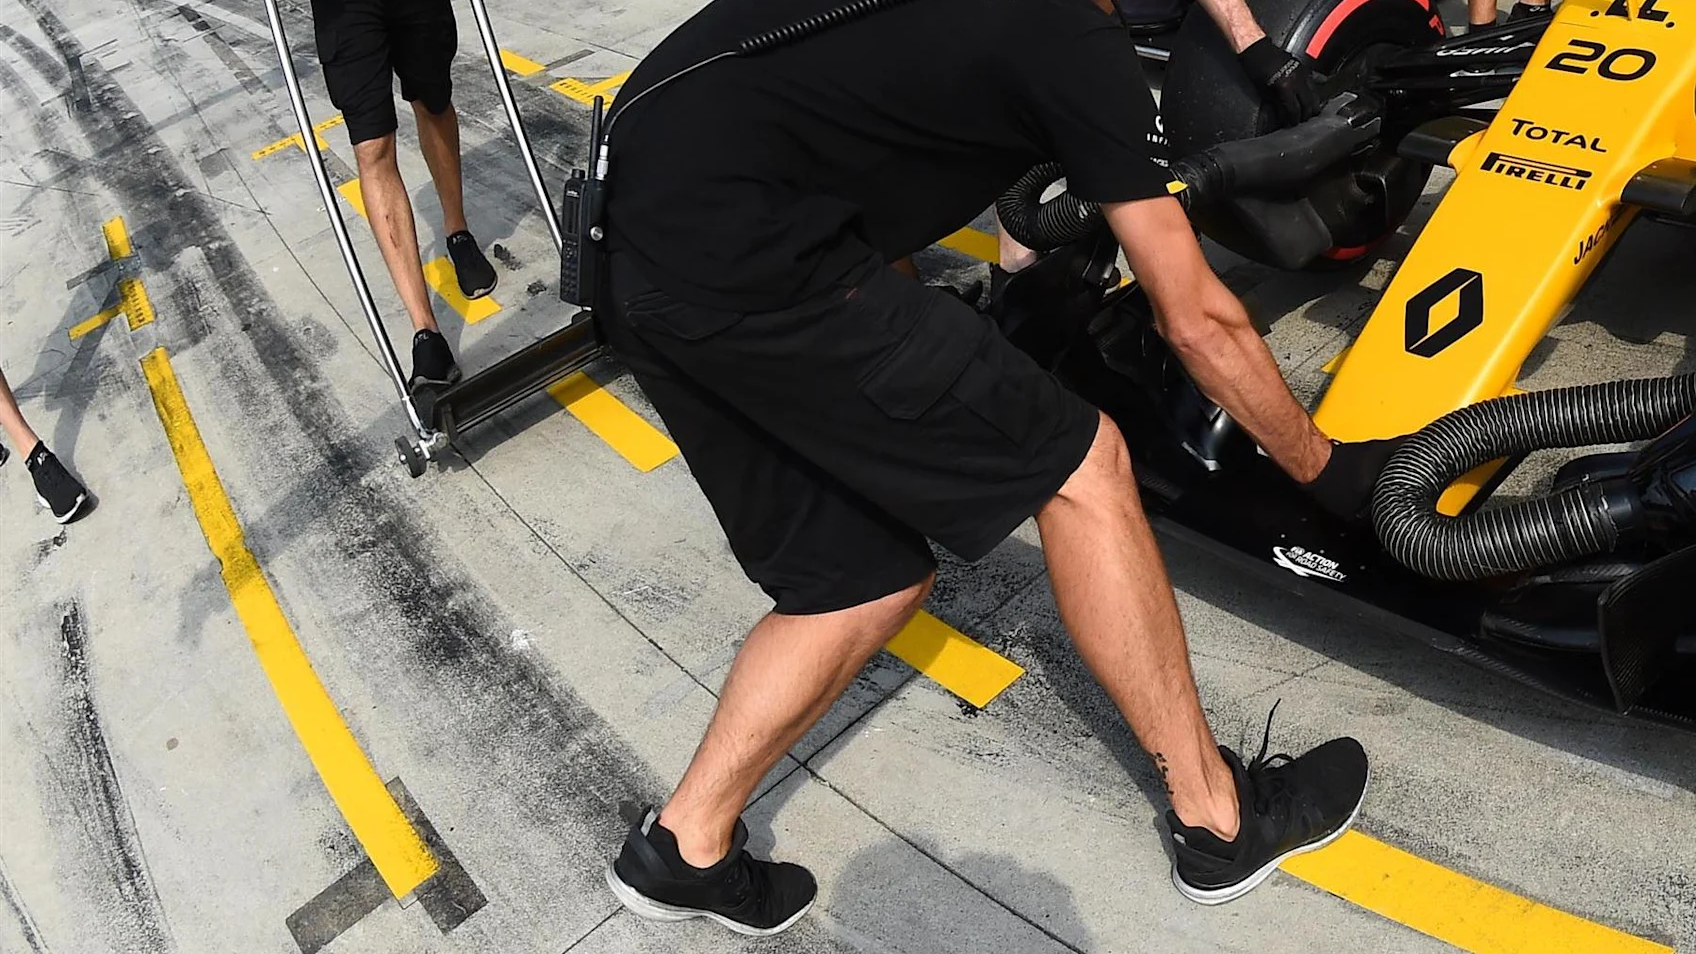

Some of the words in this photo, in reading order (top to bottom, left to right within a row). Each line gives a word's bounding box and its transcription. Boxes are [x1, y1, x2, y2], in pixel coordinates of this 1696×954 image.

[1544, 39, 1657, 81] 20
[1480, 152, 1593, 191] PIRELLI
[1295, 555, 1318, 569] ROAD
[1315, 564, 1347, 580] SAFETY
[1302, 552, 1339, 570] ACTION
